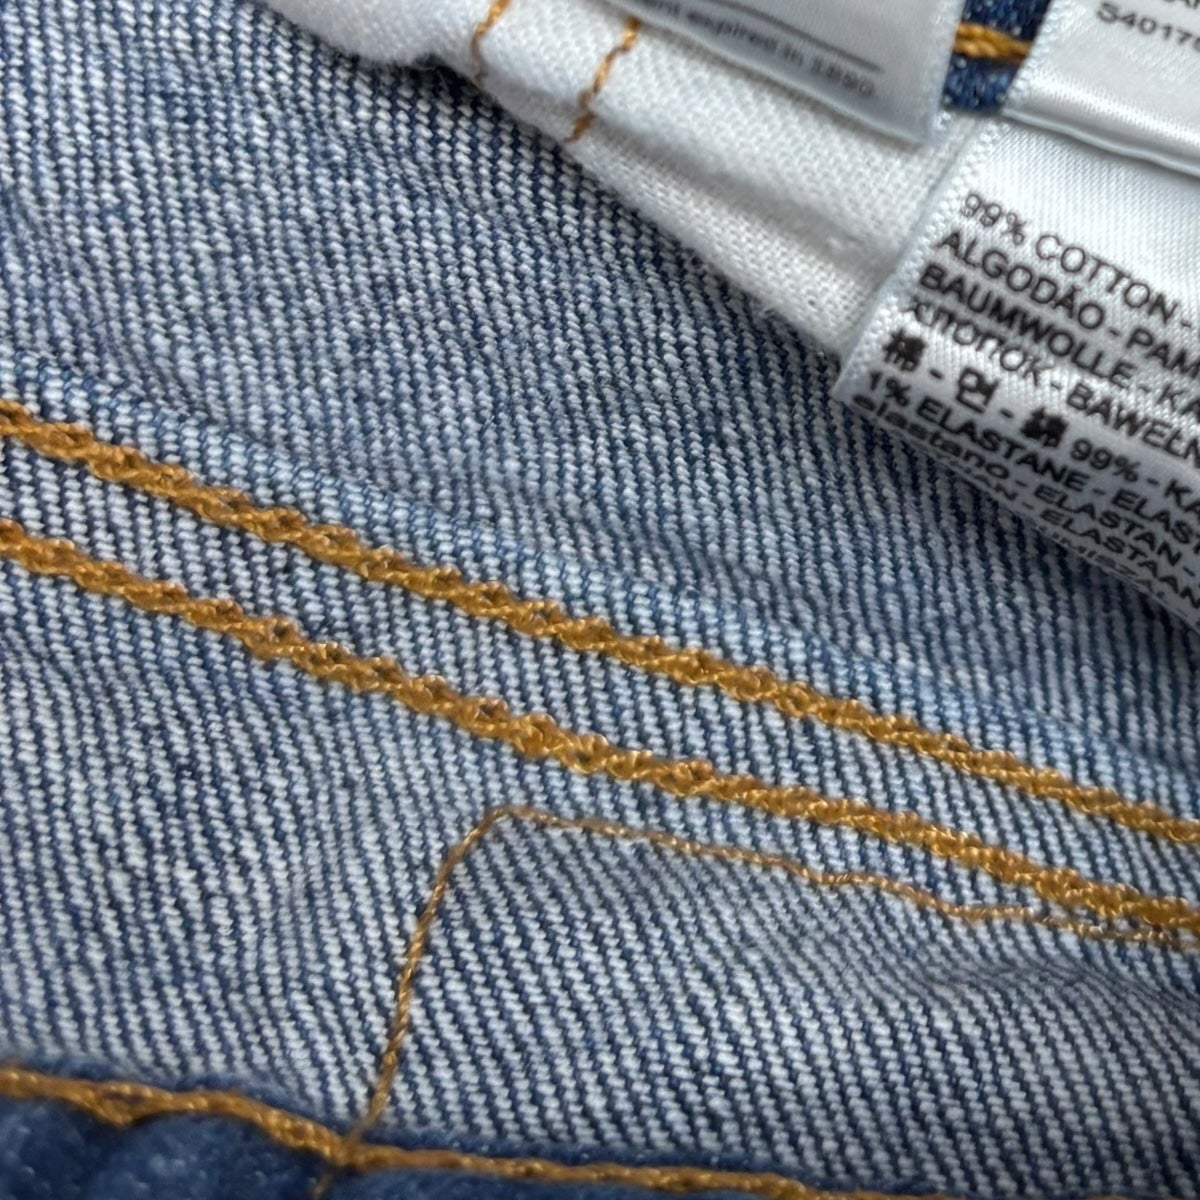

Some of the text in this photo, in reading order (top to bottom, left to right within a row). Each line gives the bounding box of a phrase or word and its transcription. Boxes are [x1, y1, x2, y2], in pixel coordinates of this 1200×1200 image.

[959, 192, 1029, 246] 99%
[1034, 233, 1179, 325] COTTON
[919, 263, 1138, 390] BAUMWOLLE
[852, 393, 1010, 480] elastano
[1034, 483, 1181, 566] ELASTAN
[869, 370, 911, 408] 1%
[916, 395, 1091, 493] ELASTANE
[956, 366, 1000, 414] 면
[1069, 437, 1140, 483] 99%
